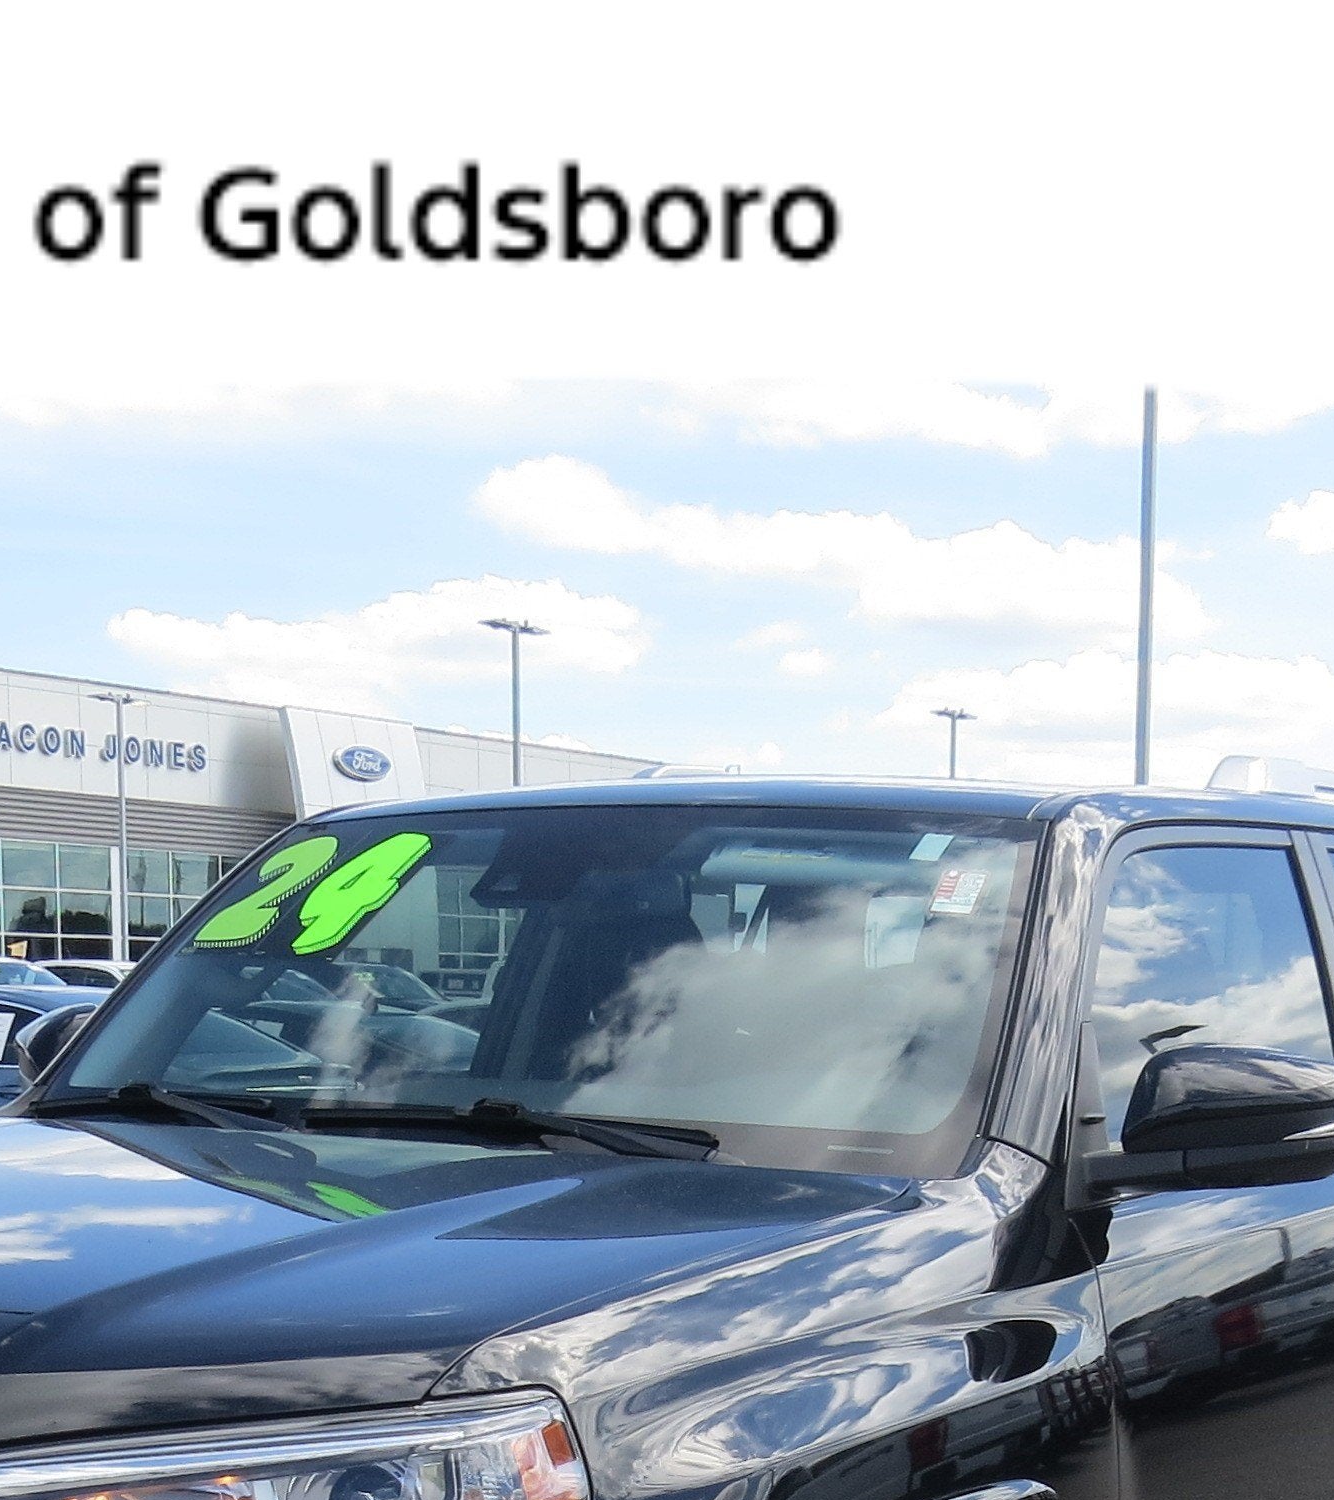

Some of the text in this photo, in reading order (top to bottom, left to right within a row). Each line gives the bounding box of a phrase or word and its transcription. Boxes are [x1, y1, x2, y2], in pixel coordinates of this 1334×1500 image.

[101, 734, 207, 771] JONES
[352, 750, 382, 772] Ford
[192, 831, 433, 956] 24
